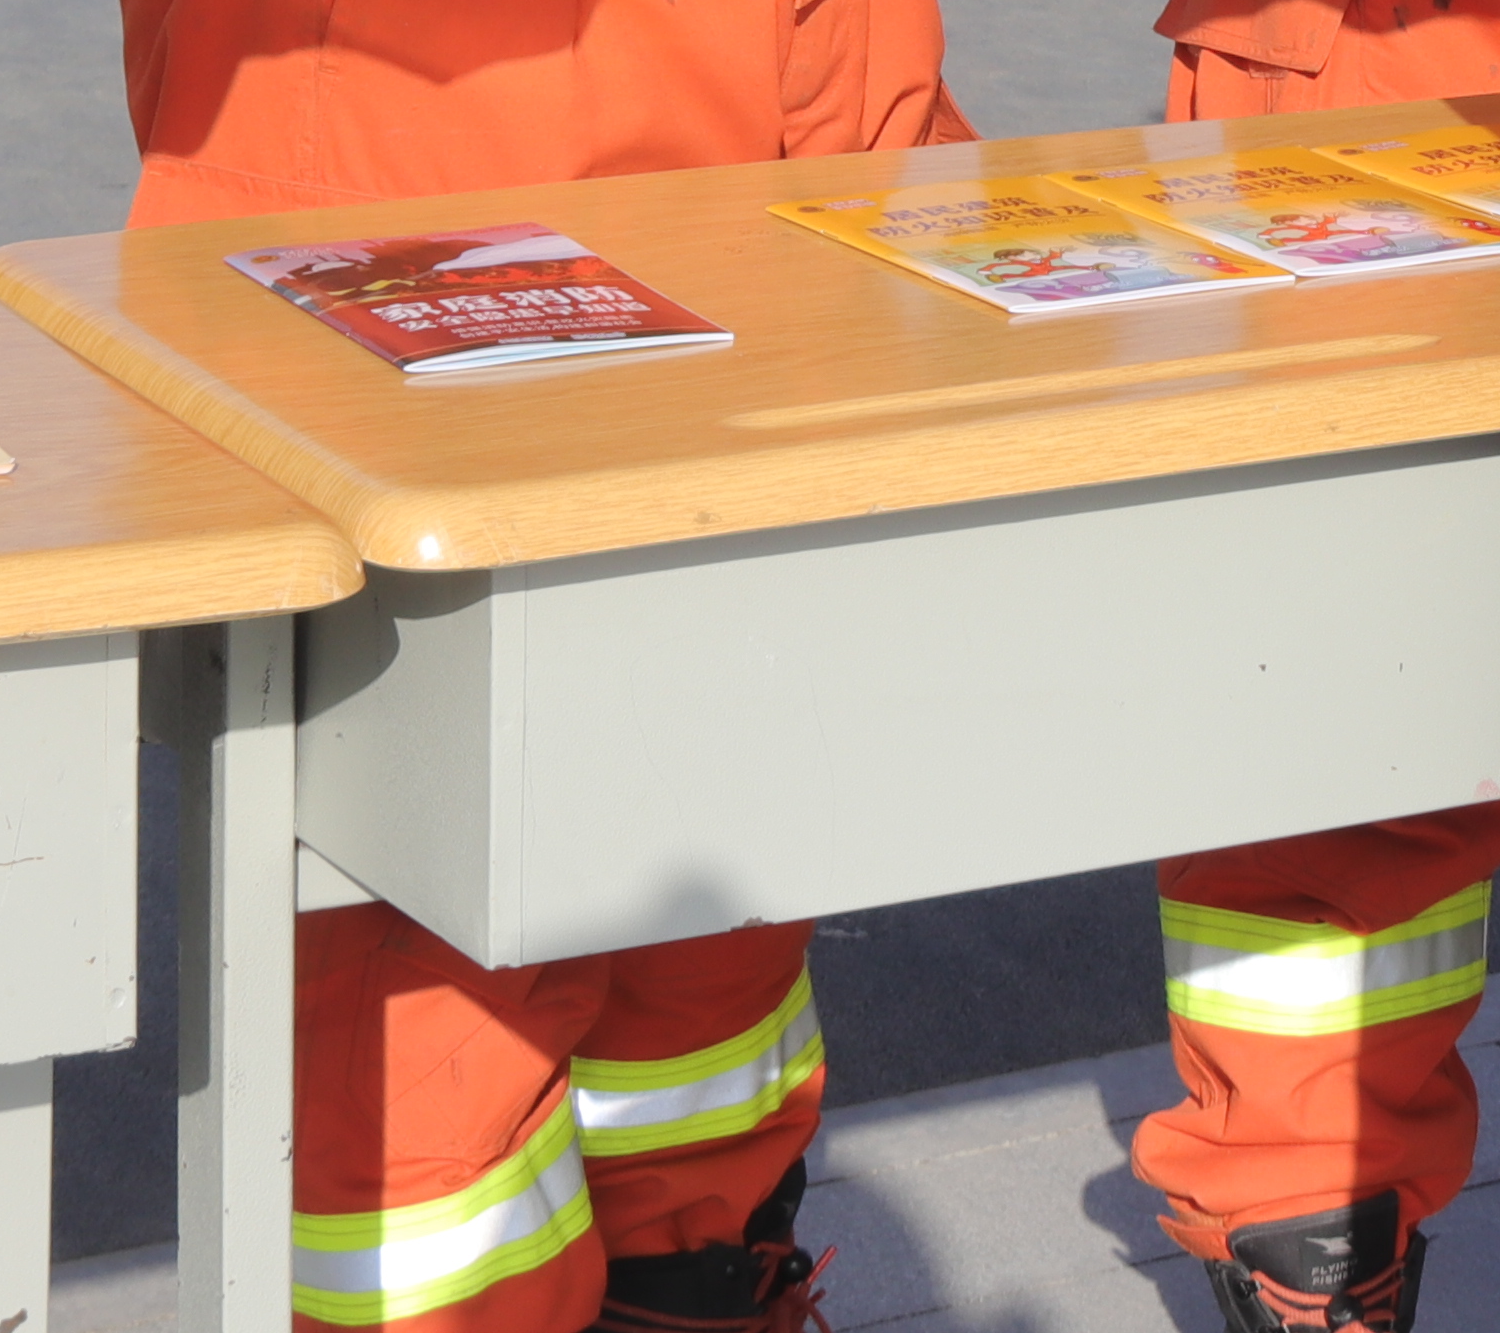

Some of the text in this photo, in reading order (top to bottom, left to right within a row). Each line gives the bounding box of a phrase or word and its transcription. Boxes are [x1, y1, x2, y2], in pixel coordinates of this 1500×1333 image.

[371, 286, 636, 321] 家庭消防
[398, 303, 652, 331] 安全隐患早知道
[1311, 1258, 1357, 1277] FLYIN
